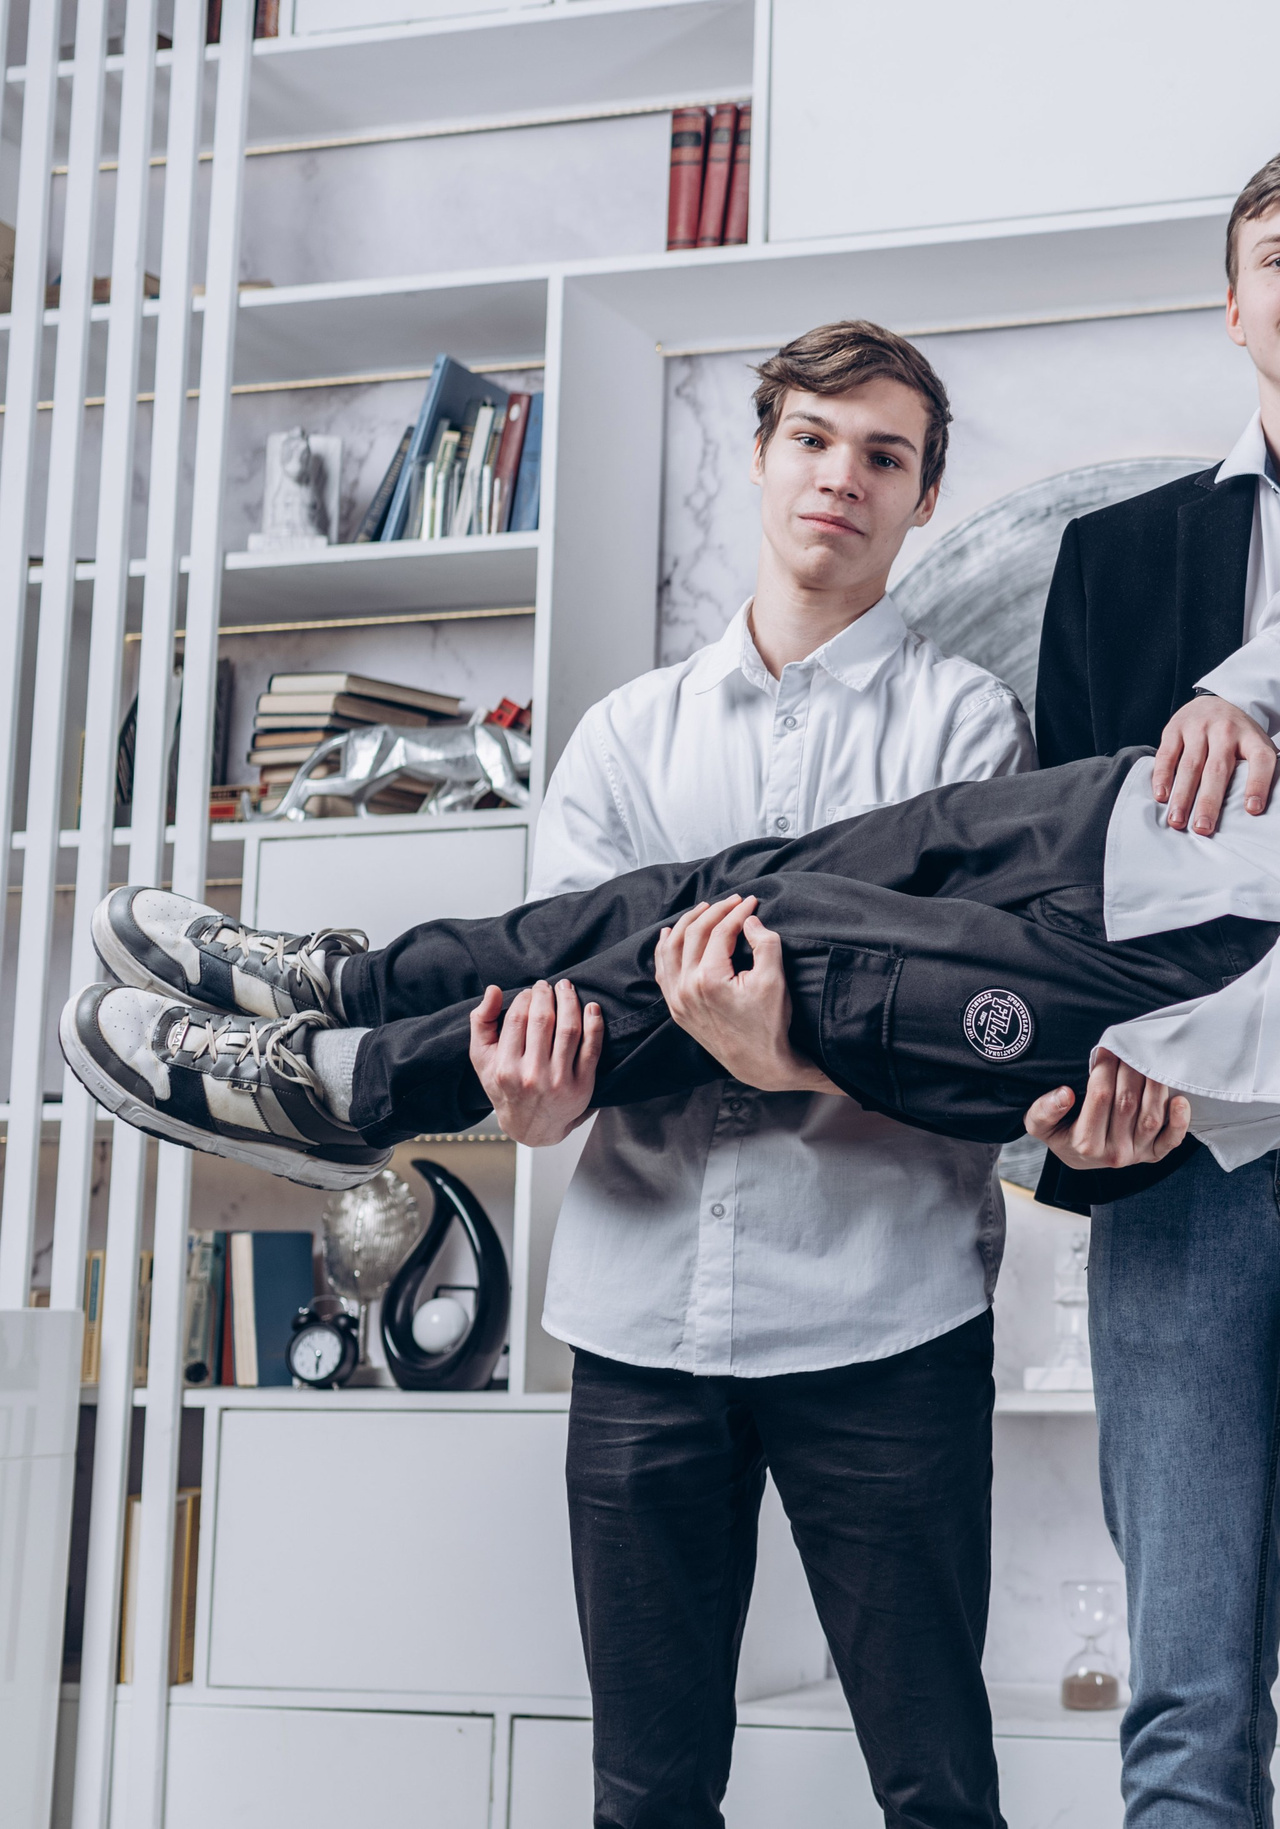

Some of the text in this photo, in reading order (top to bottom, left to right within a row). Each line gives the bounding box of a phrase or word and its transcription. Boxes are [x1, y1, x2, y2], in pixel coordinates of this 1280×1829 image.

[966, 993, 992, 1026] ESTABLISHED
[983, 997, 1013, 1049] FILA
[984, 995, 1029, 1056] SPORTSWEAR INTERNATIONAL
[231, 1082, 253, 1092] FILA
